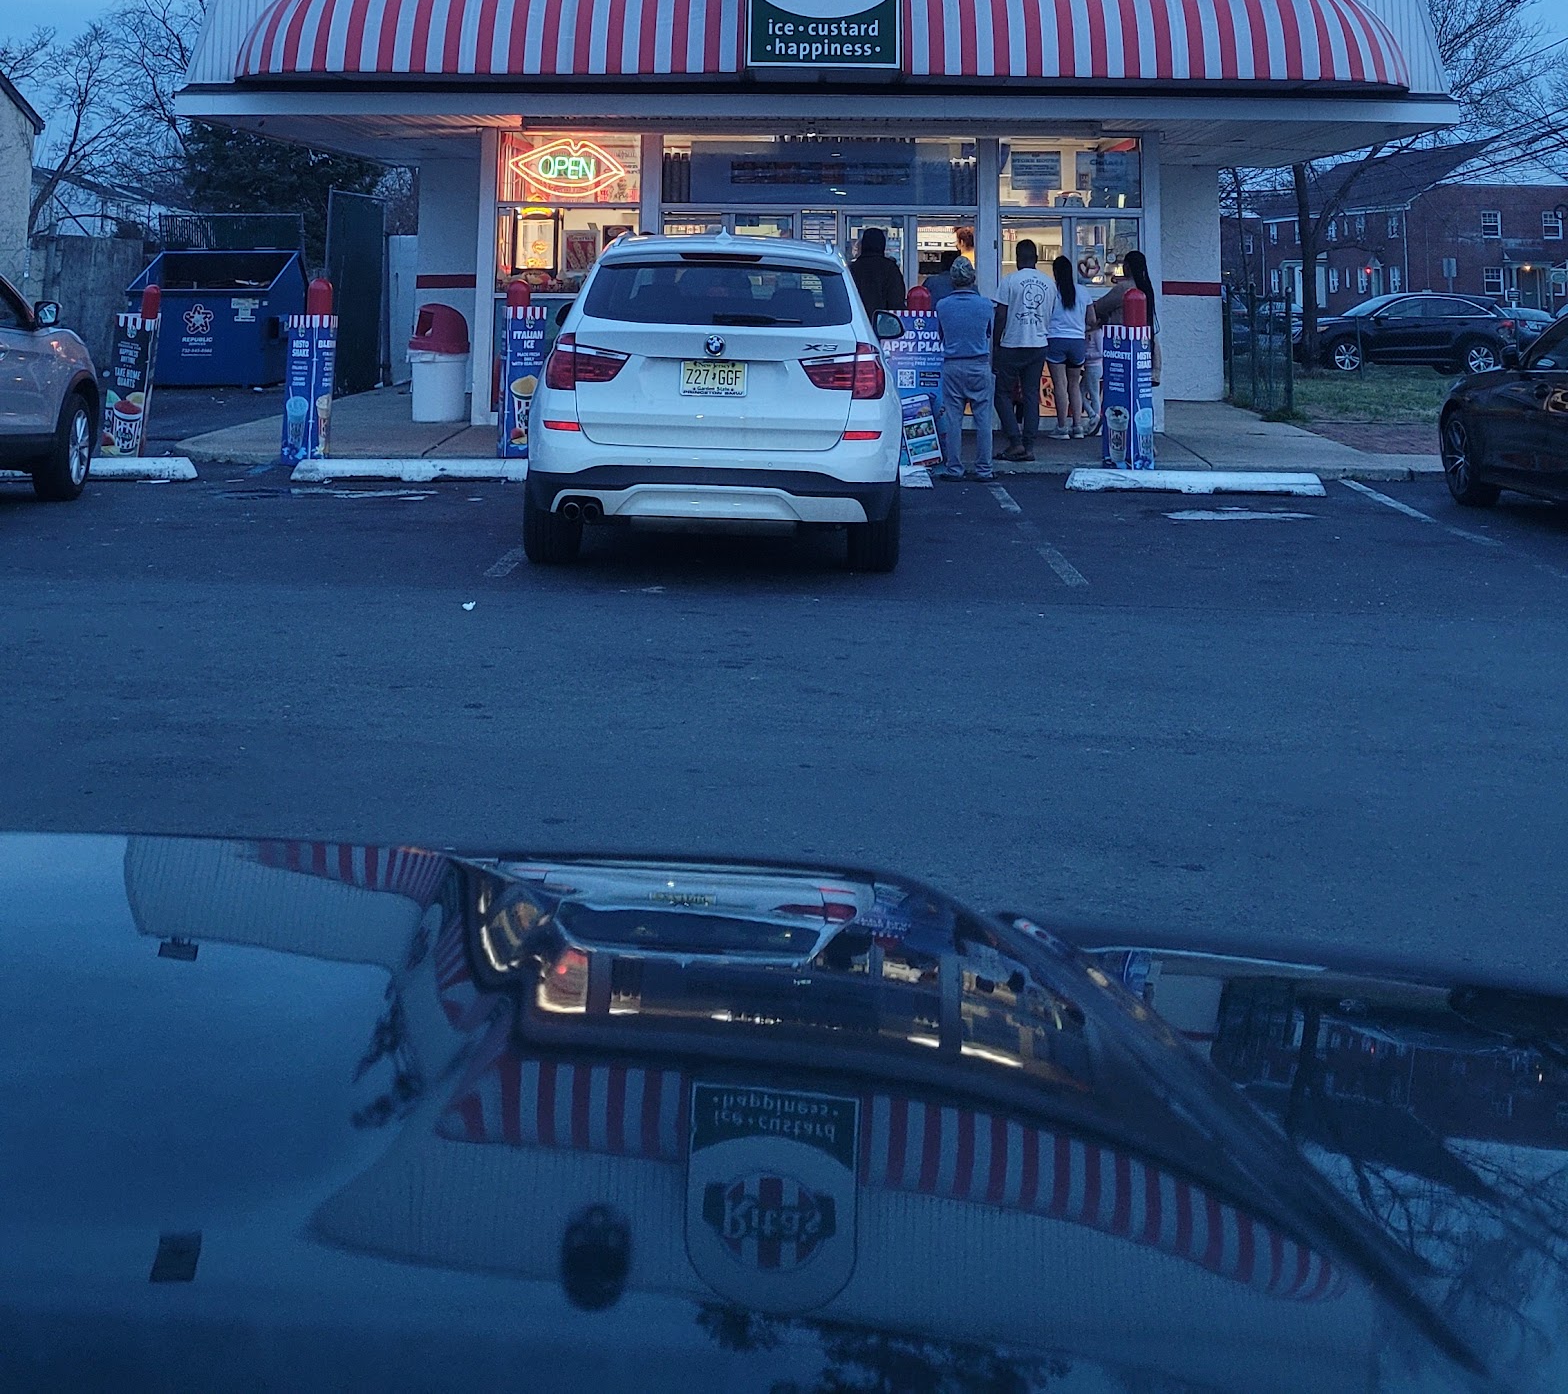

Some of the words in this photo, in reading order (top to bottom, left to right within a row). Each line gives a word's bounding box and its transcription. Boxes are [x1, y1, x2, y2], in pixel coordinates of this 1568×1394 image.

[768, 19, 794, 35] ice
[808, 20, 879, 36] custard
[775, 38, 873, 59] happiness
[538, 155, 595, 181] OPEN
[513, 330, 544, 340] ITALIAN
[902, 330, 916, 340] ND
[523, 339, 536, 349] ICE
[802, 343, 838, 352] X3
[883, 340, 916, 352] APPY
[686, 369, 709, 385] Z27
[718, 369, 742, 386] GGF
